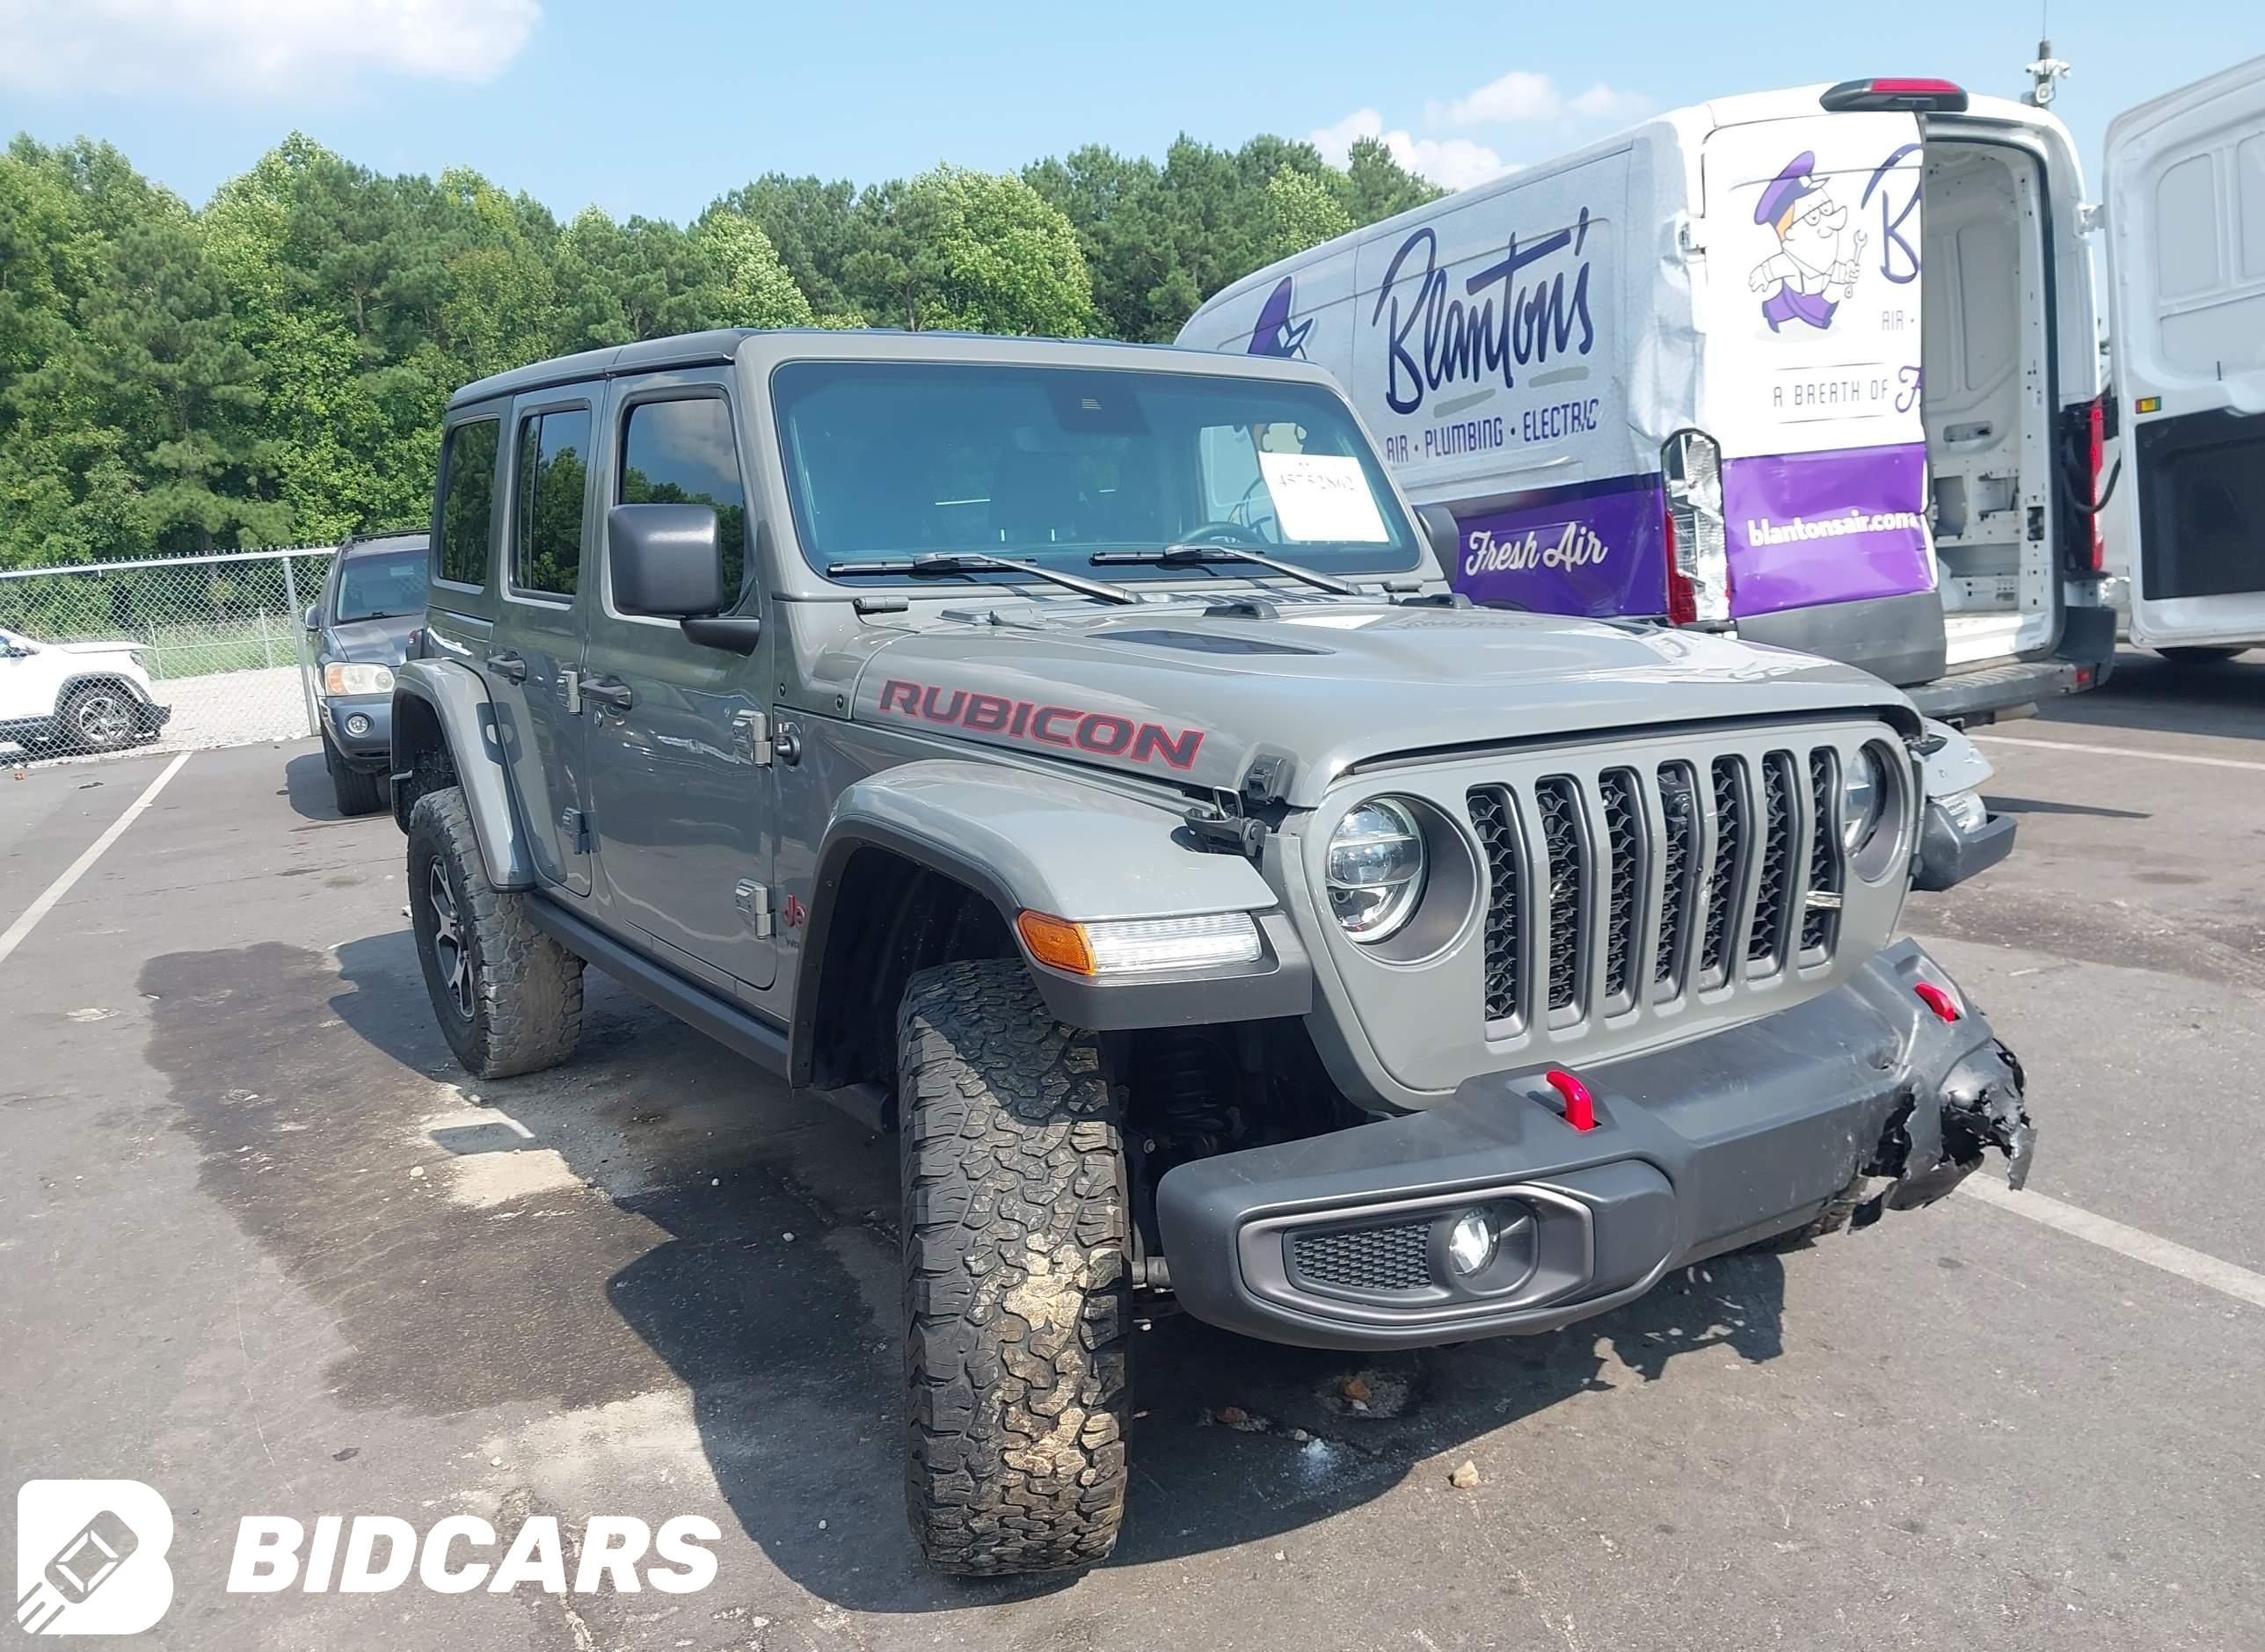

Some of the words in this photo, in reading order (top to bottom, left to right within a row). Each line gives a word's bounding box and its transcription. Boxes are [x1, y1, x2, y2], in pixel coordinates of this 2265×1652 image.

[1372, 206, 1594, 415] Blanton's
[1882, 310, 1904, 331] AIR
[1773, 386, 1783, 407] A
[1795, 381, 1860, 405] BREATH
[1870, 379, 1888, 400] OF
[1387, 434, 1409, 464] AIR
[1424, 417, 1503, 458] PLUMBING
[1523, 398, 1599, 442] ELECTRIC
[1465, 530, 1540, 576] Fresh
[1542, 521, 1608, 572] Air
[1747, 509, 1919, 547] blantonsair.com
[879, 679, 1205, 770] RUBICON
